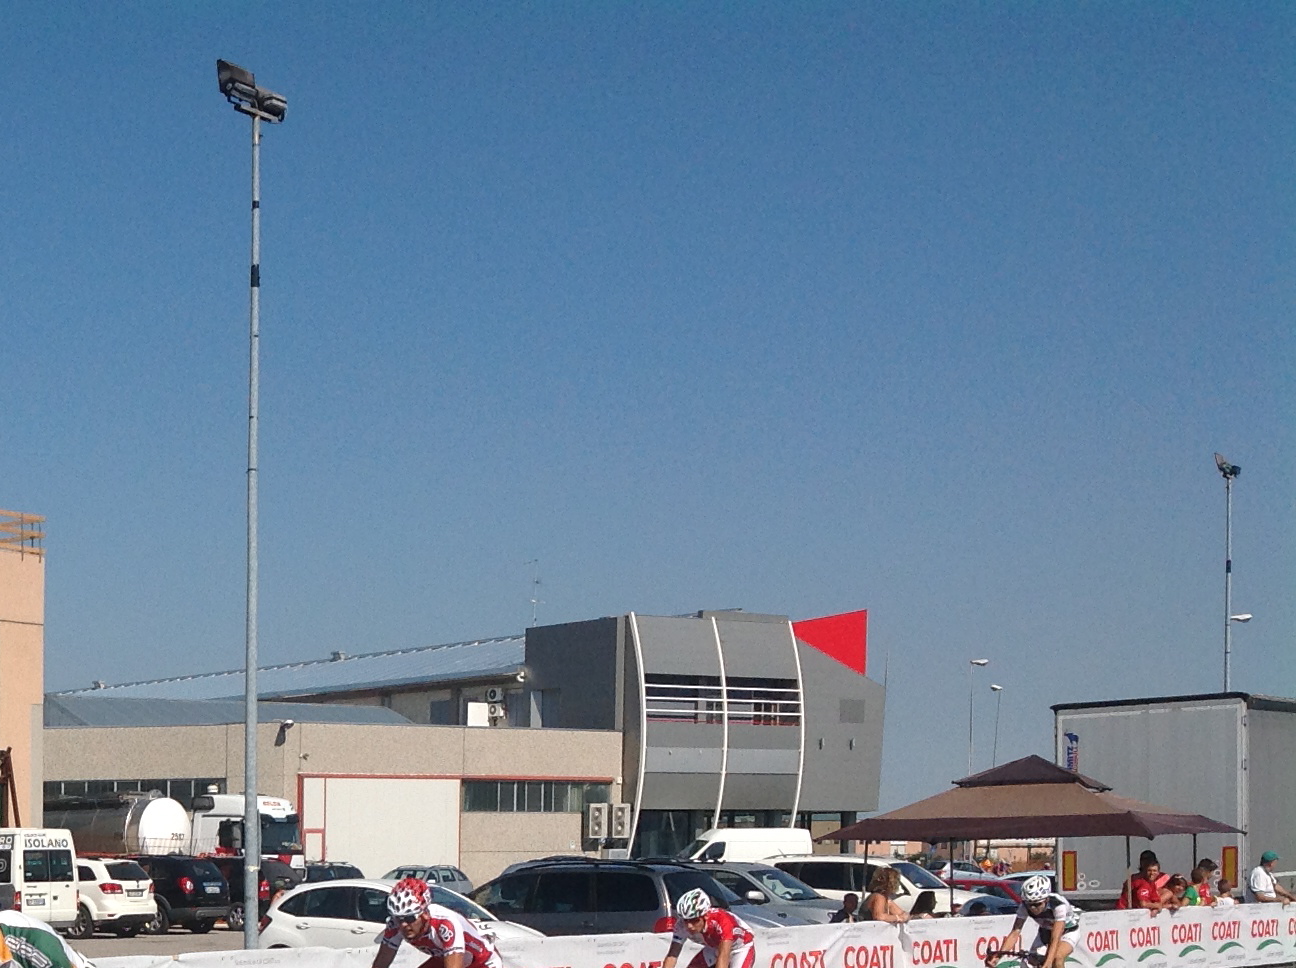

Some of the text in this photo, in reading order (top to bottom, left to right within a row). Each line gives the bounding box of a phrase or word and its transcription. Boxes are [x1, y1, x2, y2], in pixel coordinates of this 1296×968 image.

[24, 838, 69, 848] ISOLANO
[1130, 926, 1160, 948] COATI
[1172, 923, 1202, 944] COATI
[1212, 921, 1241, 941] COATI
[1251, 919, 1279, 938] COATI
[912, 938, 958, 965] COATI
[1087, 930, 1119, 952] COATI
